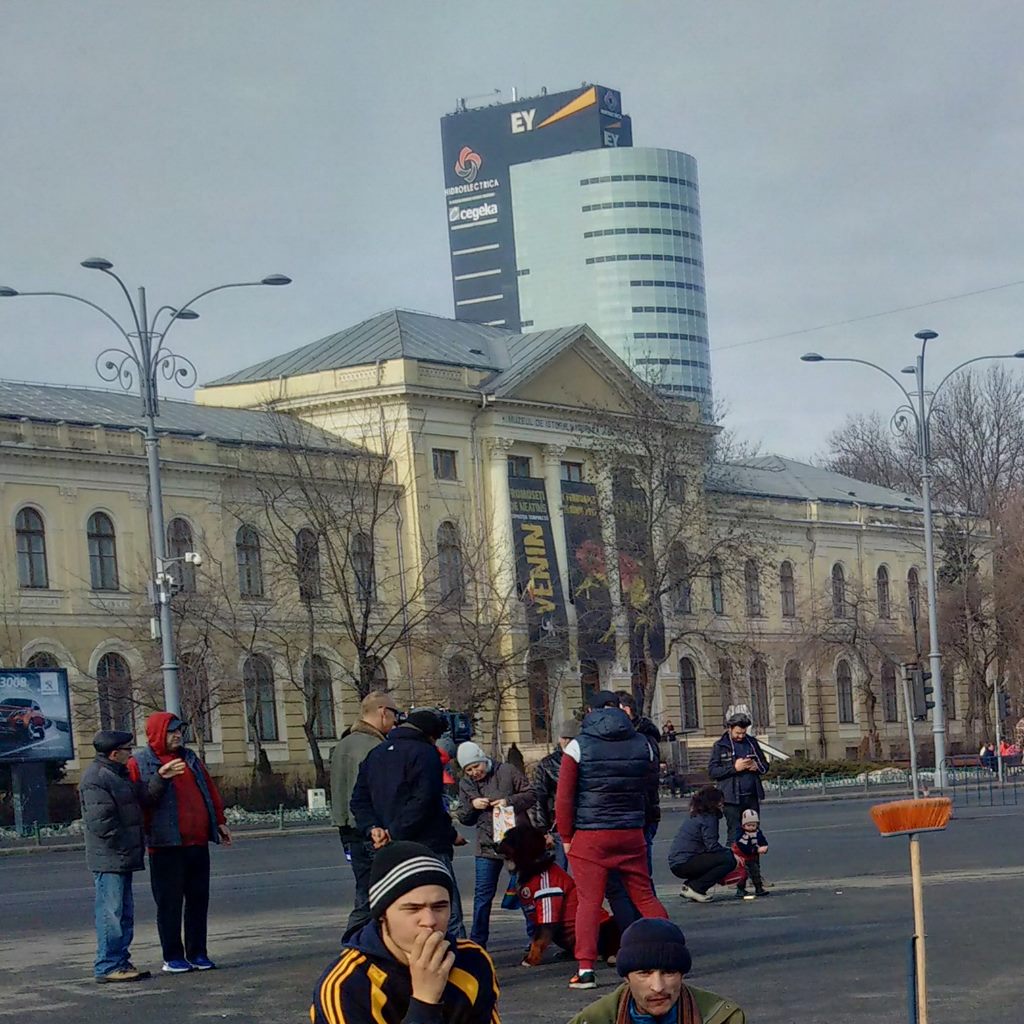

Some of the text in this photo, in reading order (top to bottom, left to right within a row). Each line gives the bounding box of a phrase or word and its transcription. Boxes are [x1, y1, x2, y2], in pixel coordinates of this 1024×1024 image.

[510, 108, 537, 134] EY
[604, 130, 619, 147] EY
[445, 179, 499, 196] HIDROELECTRICA
[460, 203, 498, 220] cegeka
[521, 523, 557, 614] VENIN
[0, 677, 28, 688] 3008
